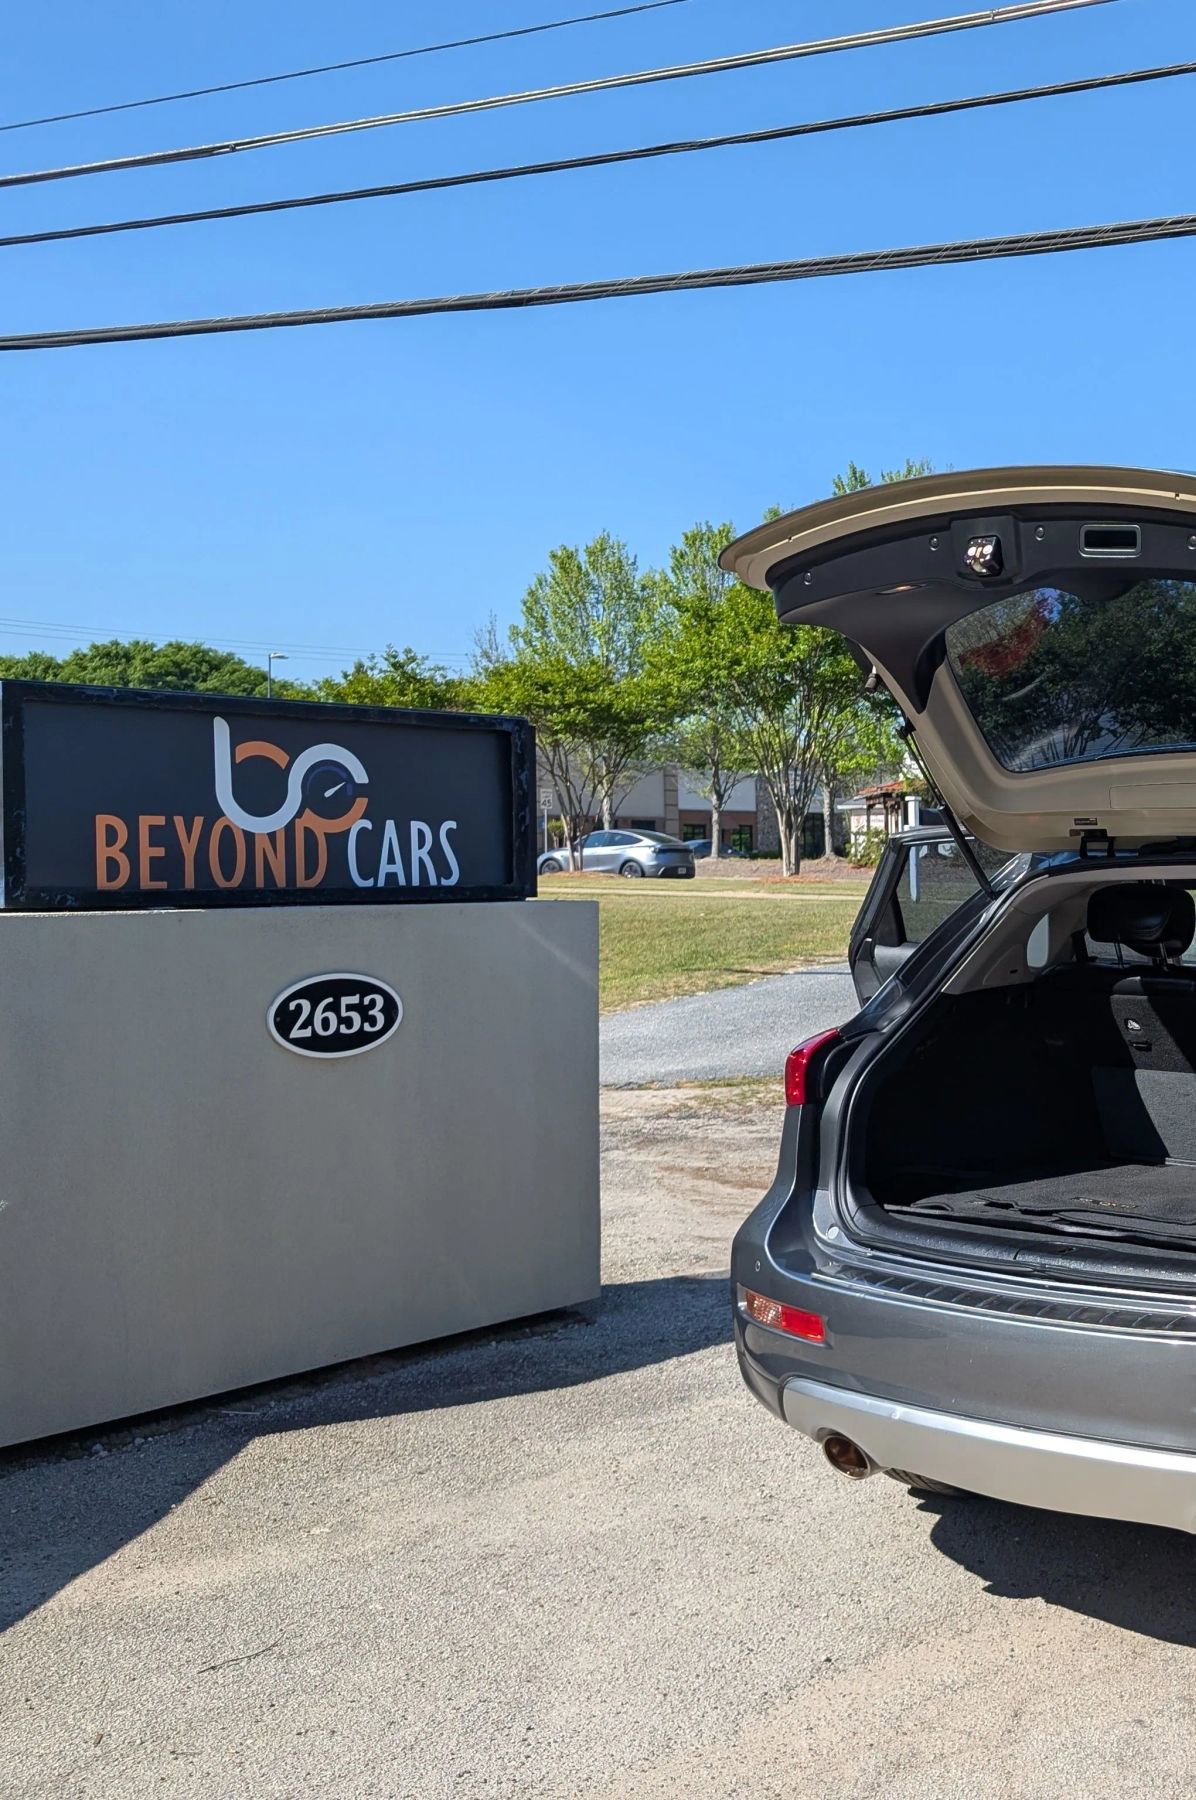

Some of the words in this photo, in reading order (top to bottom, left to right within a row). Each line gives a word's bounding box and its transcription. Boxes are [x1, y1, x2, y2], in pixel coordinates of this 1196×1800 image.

[541, 799, 552, 807] 45
[95, 814, 328, 890] BEYOND
[347, 819, 460, 888] CARS
[288, 993, 386, 1039] 2653
